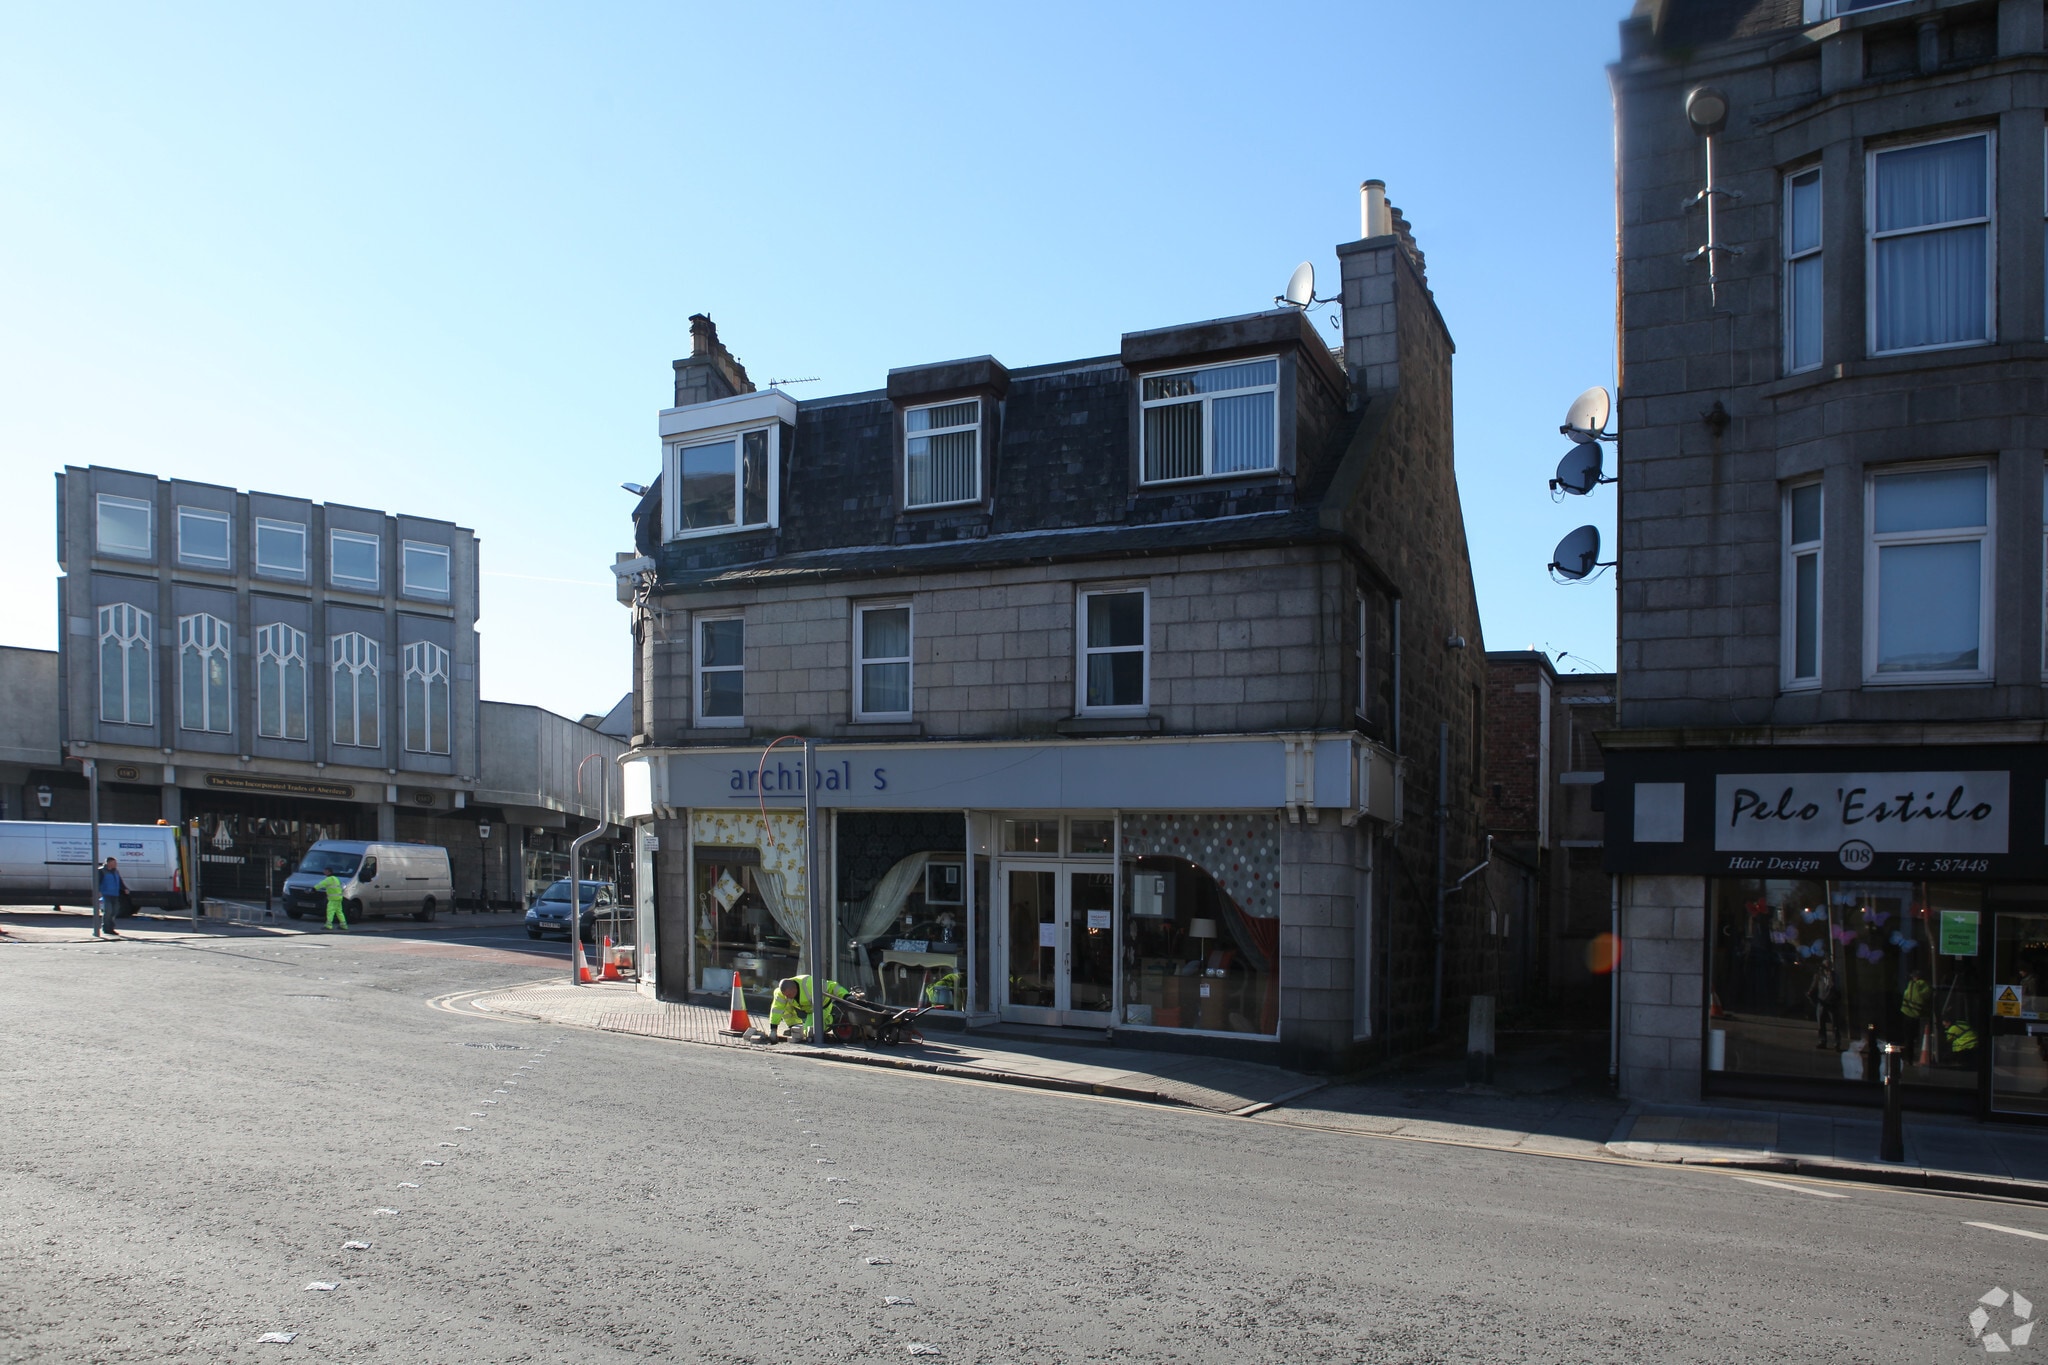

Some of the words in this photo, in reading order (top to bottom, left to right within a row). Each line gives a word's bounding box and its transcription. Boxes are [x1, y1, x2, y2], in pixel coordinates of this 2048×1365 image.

[211, 777, 224, 785] The
[225, 779, 244, 787] Seven
[245, 780, 286, 791] Incorporated
[287, 783, 307, 792] Trades
[317, 786, 347, 795] Aberdeen
[1731, 787, 1820, 828] Pelo
[1728, 856, 1764, 870] Hair
[1767, 857, 1820, 872] Design
[1842, 847, 1871, 864] 108
[1931, 859, 1989, 873] 587448
